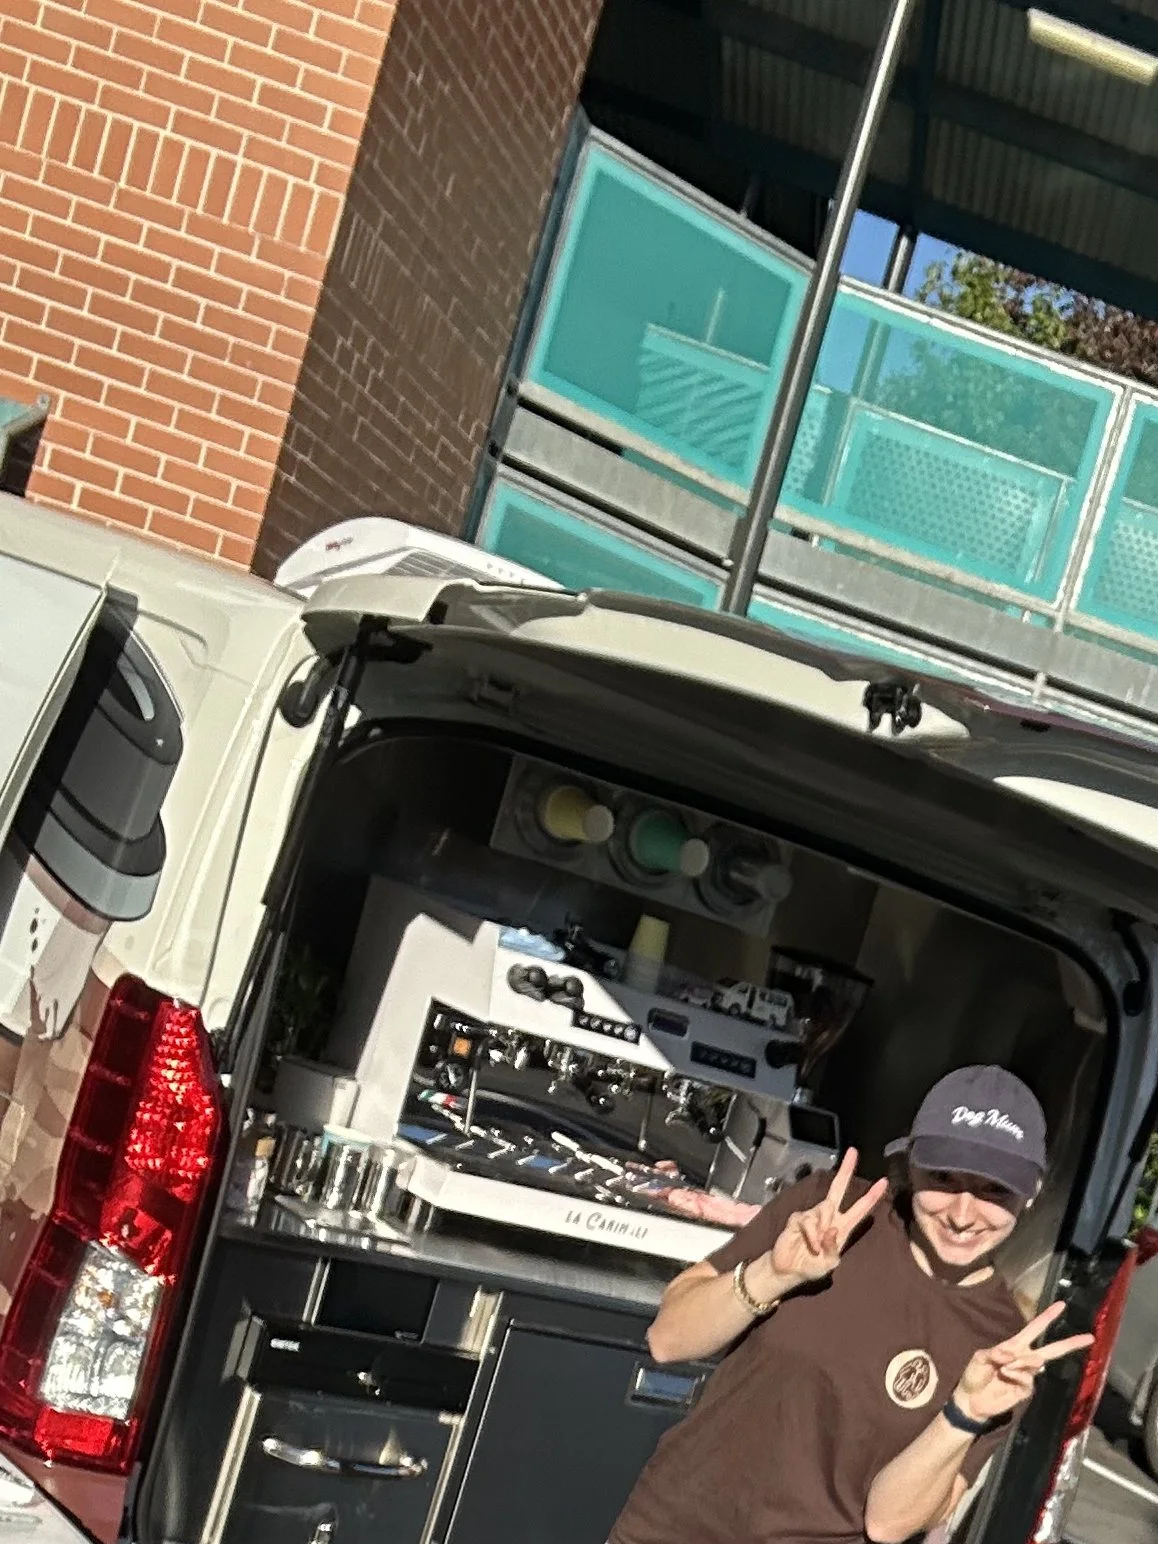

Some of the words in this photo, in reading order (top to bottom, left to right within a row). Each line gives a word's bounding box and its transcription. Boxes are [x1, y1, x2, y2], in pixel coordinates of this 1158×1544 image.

[951, 1105, 986, 1128] Dog
[983, 1108, 1025, 1140] Mum
[564, 1210, 582, 1225] LA
